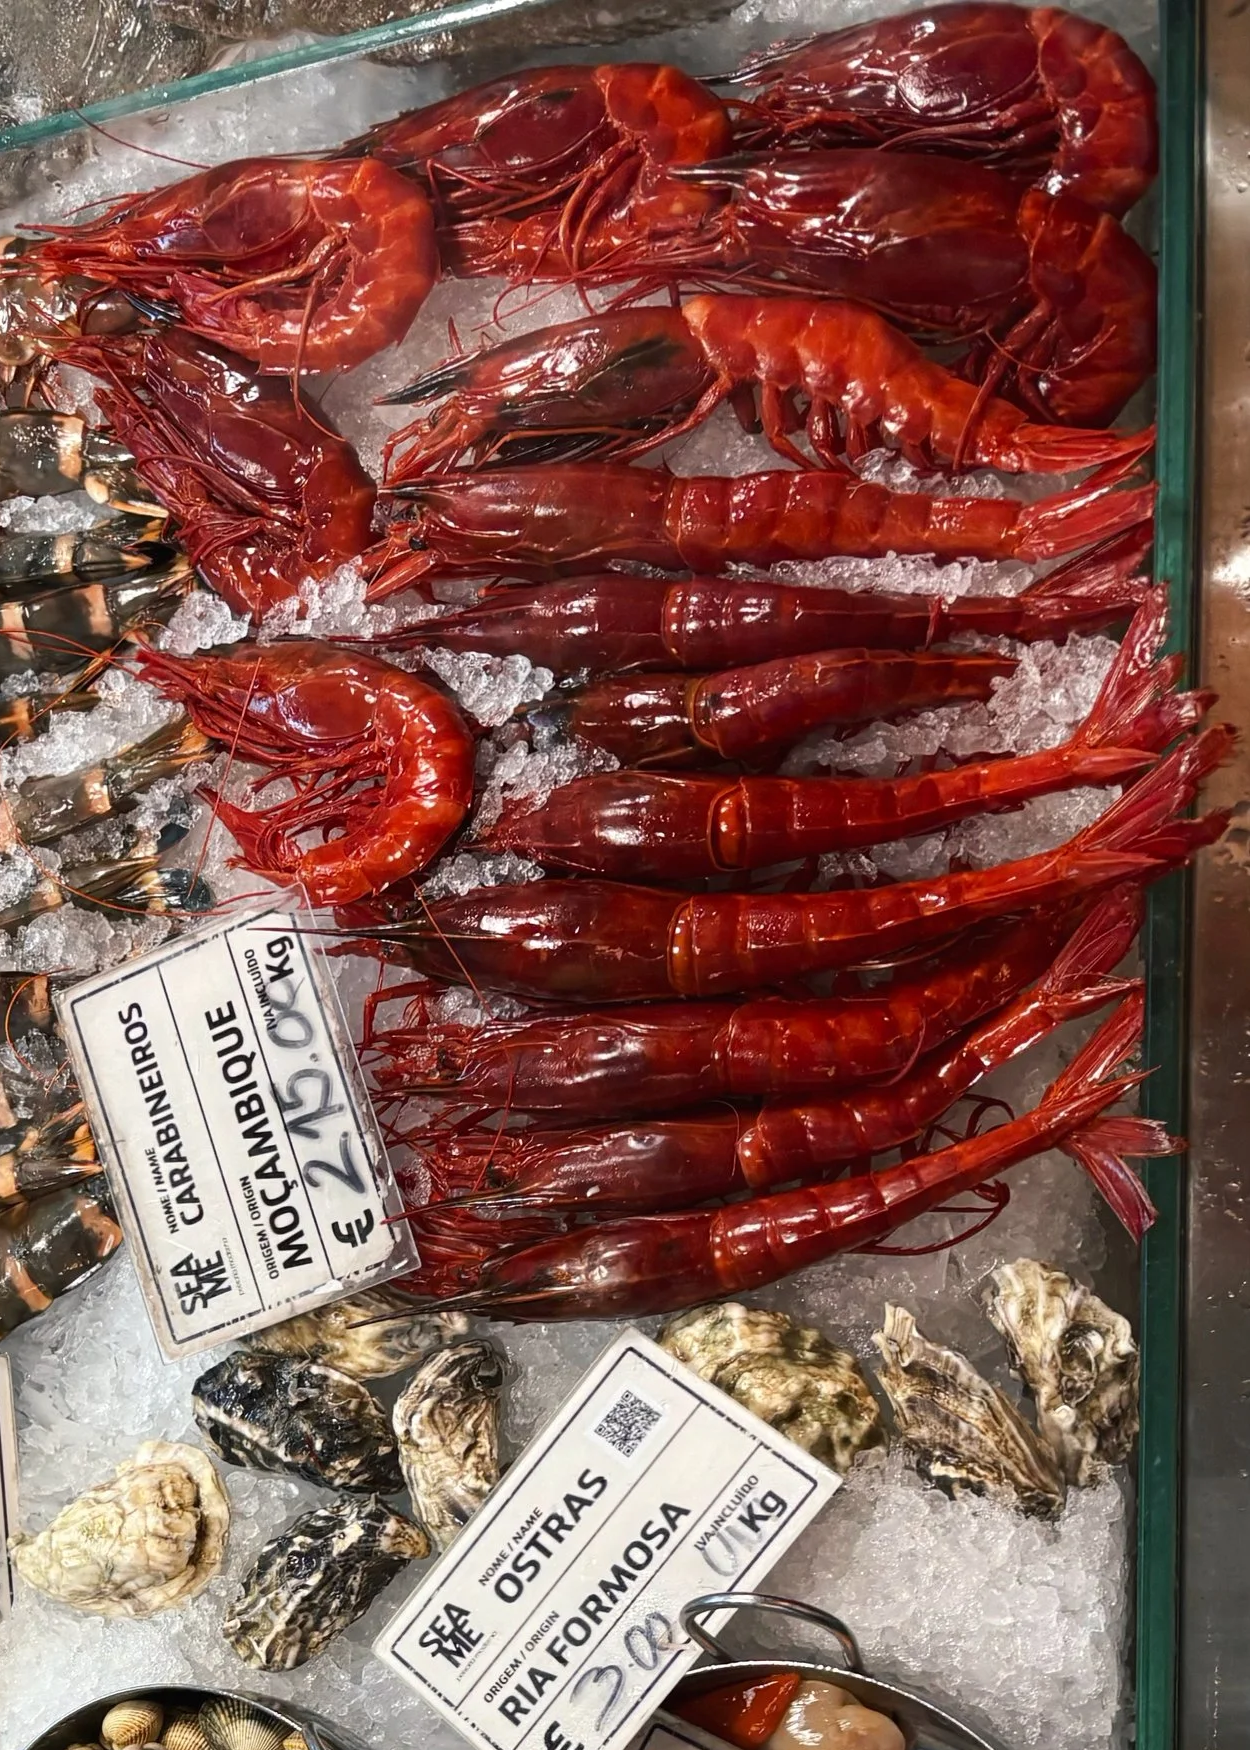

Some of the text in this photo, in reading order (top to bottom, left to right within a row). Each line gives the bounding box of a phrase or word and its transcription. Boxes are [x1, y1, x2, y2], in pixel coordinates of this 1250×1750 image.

[244, 949, 279, 1031] IVA INCLUÍDO
[265, 935, 294, 980] Kg
[118, 1002, 204, 1226] CARABINEIROS
[204, 1000, 313, 1269] MOÇAMBIQUE
[145, 1147, 179, 1234] NOME NAME
[239, 1175, 279, 1280] ORIGEM ORIGIN
[331, 1209, 375, 1248] €
[169, 1252, 210, 1315] SEA
[193, 1250, 233, 1302] ME
[494, 1468, 608, 1604] OSTRAS
[711, 1475, 759, 1530] INCLUÍDO
[738, 1490, 788, 1532] Kg
[478, 1507, 543, 1587] NOME NAME
[418, 1603, 471, 1658] SEA
[438, 1626, 484, 1666] ME
[498, 1503, 691, 1727] RIA FORMOSA
[483, 1610, 560, 1703] ORIGEM ORIGIN
